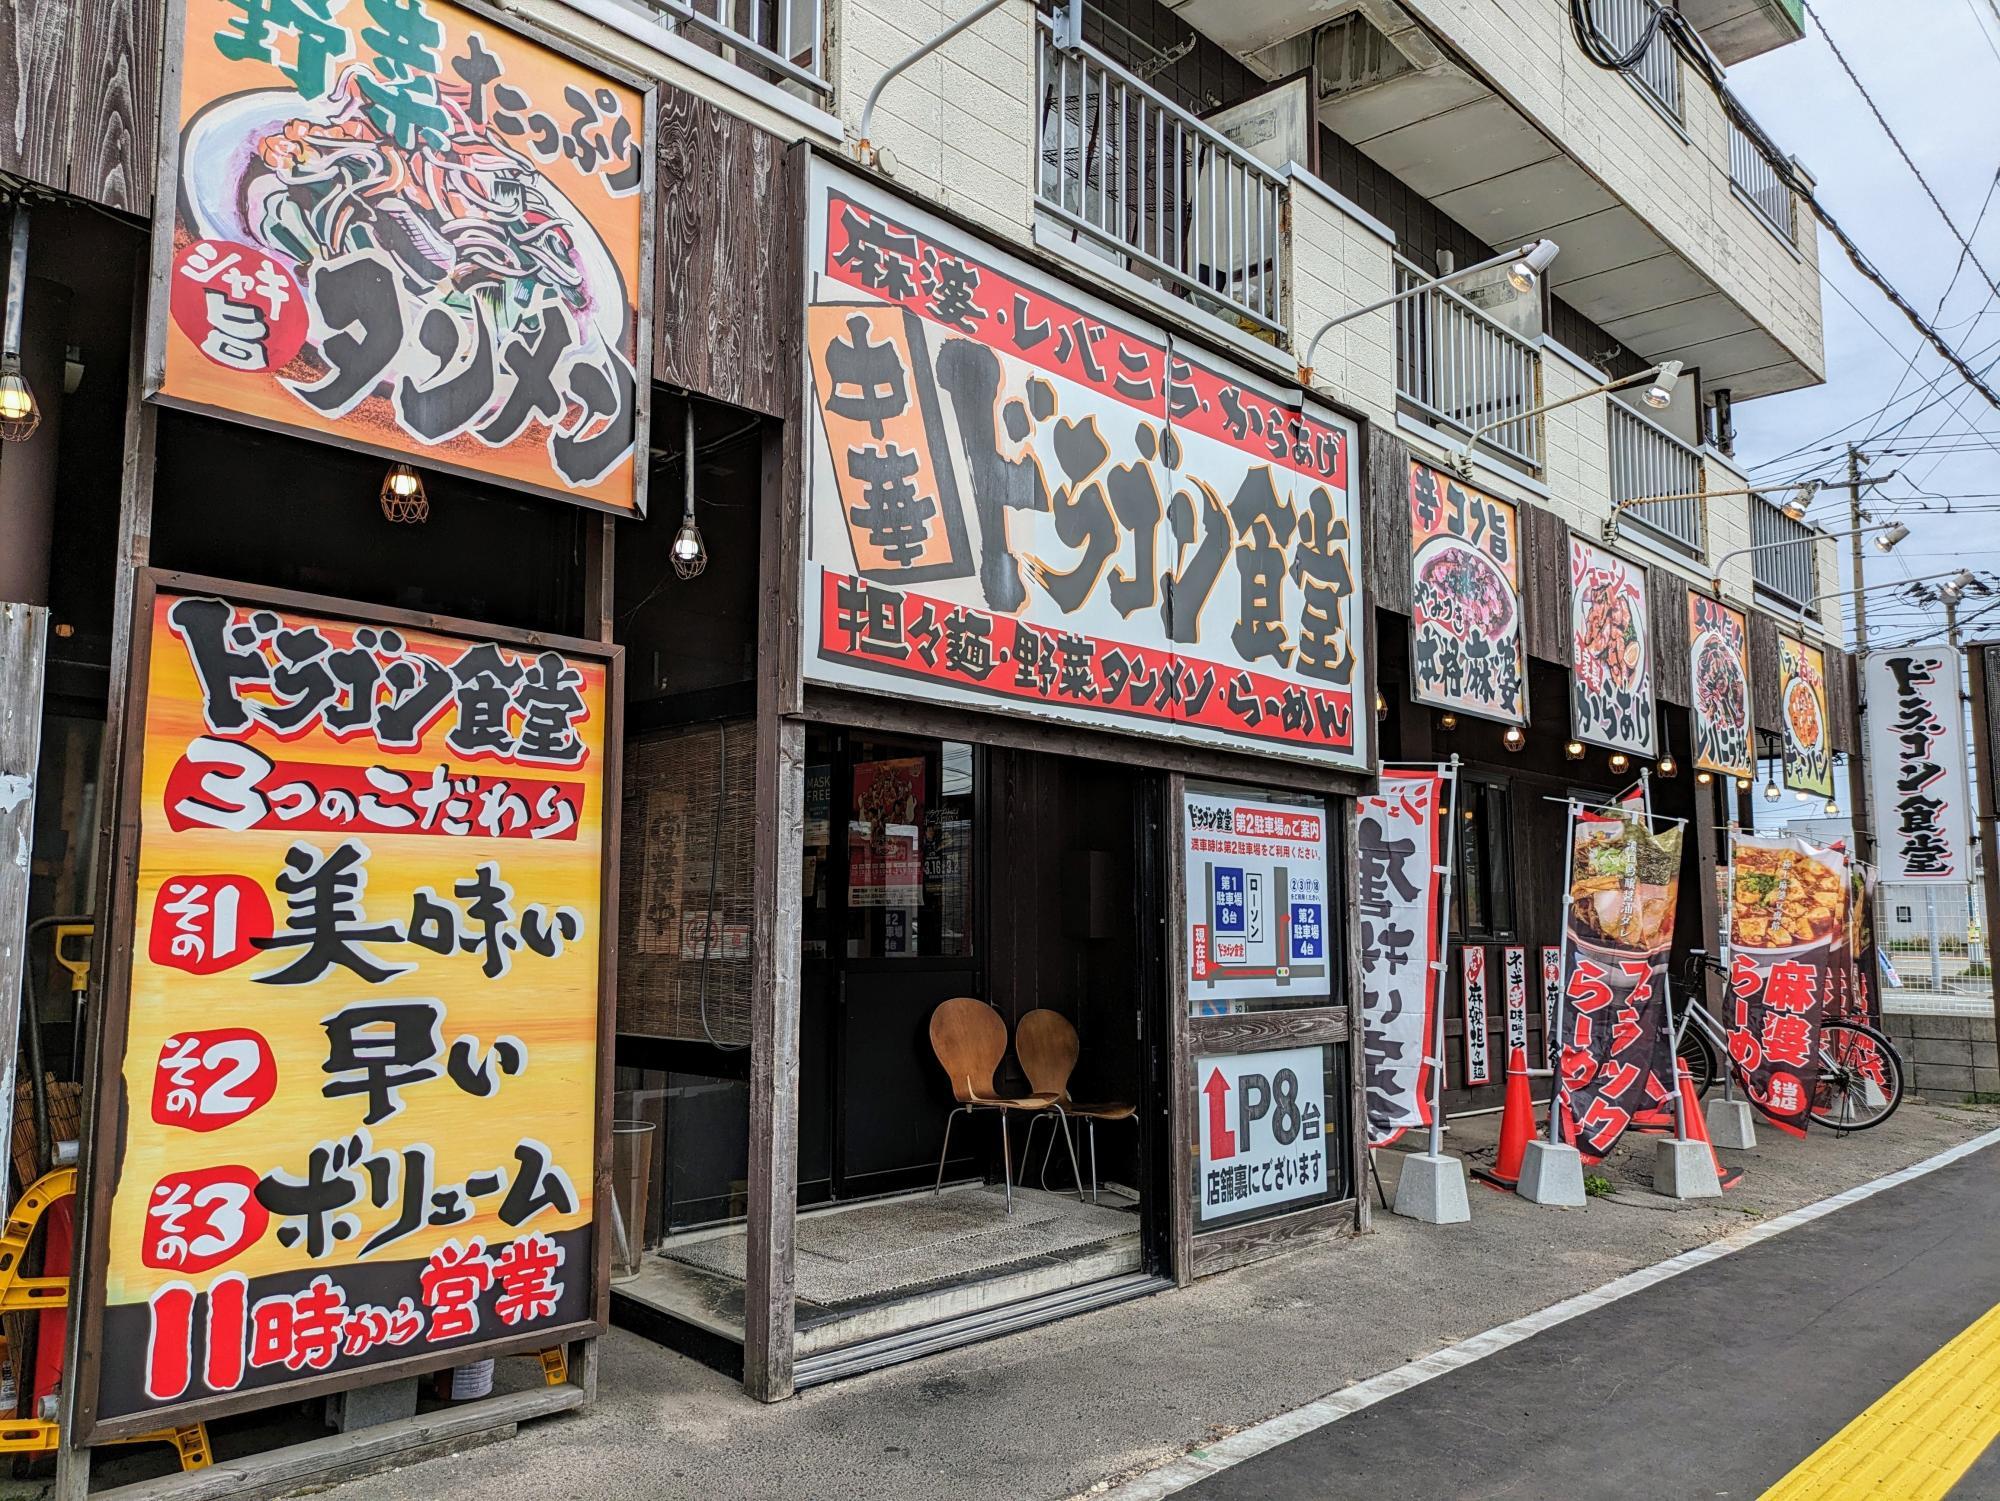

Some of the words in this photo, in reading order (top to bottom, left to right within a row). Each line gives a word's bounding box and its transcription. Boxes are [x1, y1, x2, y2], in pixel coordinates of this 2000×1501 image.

[180, 243, 292, 320] シャキ
[201, 291, 268, 370] 旨
[277, 253, 636, 488] タンメン
[825, 313, 937, 568] 中華
[935, 337, 1356, 686] ドラゴン食堂
[1413, 580, 1464, 635] やみつき
[1572, 543, 1640, 599] ジューシー
[168, 597, 591, 771] ドラゴン食堂
[1576, 674, 1650, 747] からあげ
[174, 736, 575, 839] 3つのこだわり
[1885, 657, 1953, 876] ドラゴン食堂
[1188, 804, 1232, 833] ドラゴン食堂
[1236, 813, 1319, 839] 第2駐車場のご案内
[249, 837, 583, 984] 美味い
[1217, 892, 1242, 906] 駐車場
[1221, 875, 1237, 891] 第1
[1222, 908, 1237, 924] 8台
[1250, 879, 1259, 938] ローソン
[1298, 908, 1315, 923] 第2
[1195, 928, 1206, 975] 現在地
[1294, 925, 1319, 939] 駐車場
[1300, 941, 1314, 956] 4台
[1762, 960, 1817, 1068] 麻婆
[320, 998, 528, 1125] 早い
[1589, 961, 1653, 1151] ブラック
[255, 1129, 579, 1259] ボリューム
[1207, 1149, 1322, 1206] 店舗裏にございます
[146, 1231, 565, 1400] 11時から営業
